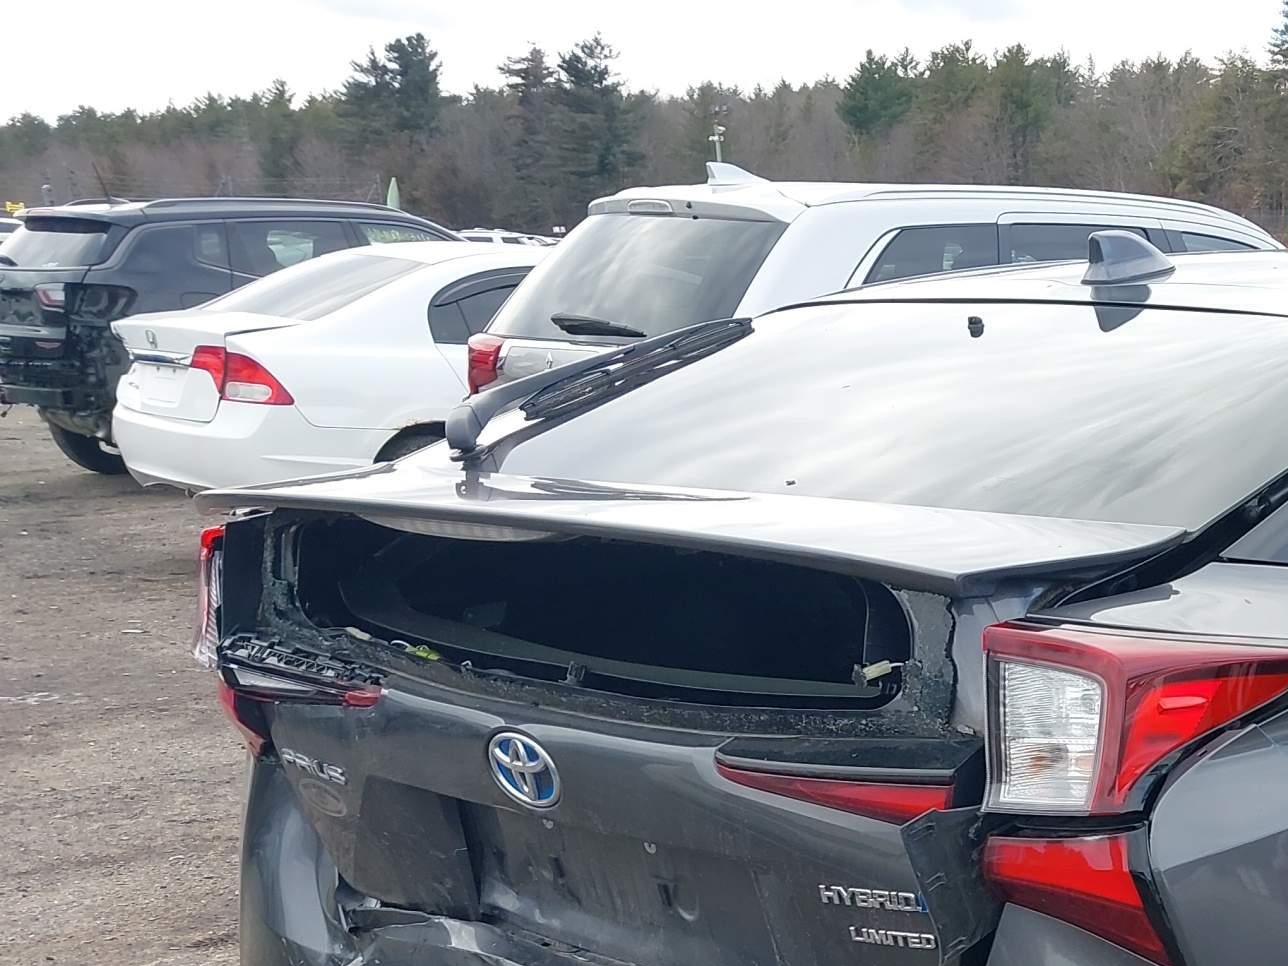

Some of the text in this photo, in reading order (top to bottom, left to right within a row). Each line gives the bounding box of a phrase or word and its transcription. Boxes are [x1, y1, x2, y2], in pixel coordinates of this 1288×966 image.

[280, 747, 347, 786] PRIUS
[818, 884, 923, 912] HYBRID
[848, 924, 937, 949] LIMITED
